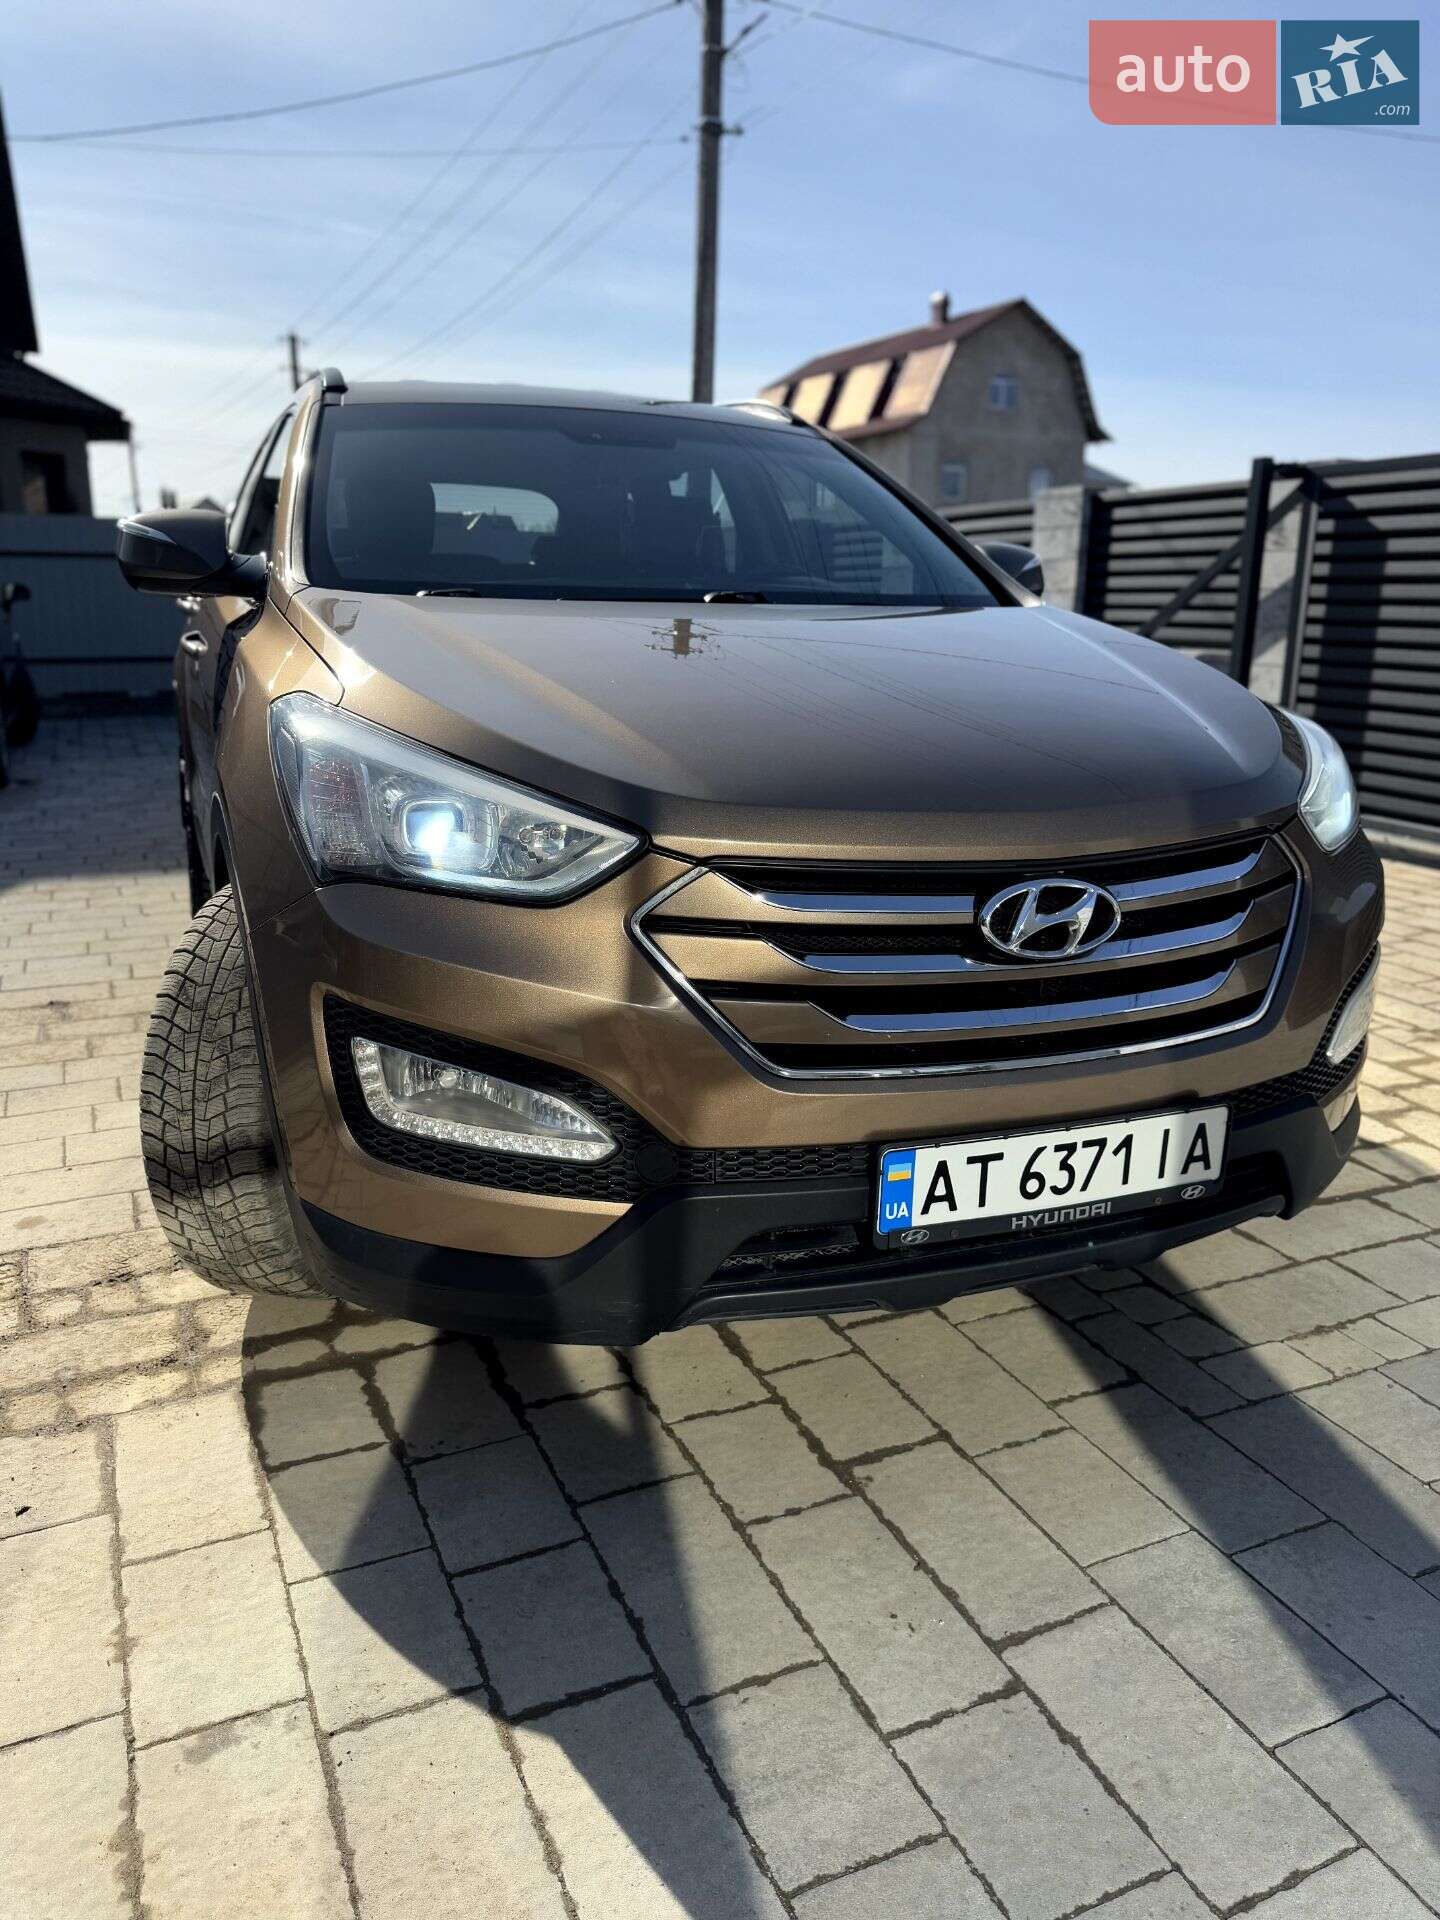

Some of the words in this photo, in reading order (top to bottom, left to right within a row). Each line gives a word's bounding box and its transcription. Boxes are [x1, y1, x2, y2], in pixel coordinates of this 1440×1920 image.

[920, 1152, 1004, 1216] AT
[1018, 1133, 1134, 1200] 6371
[1158, 1123, 1211, 1179] IA
[885, 1202, 909, 1220] UA
[1011, 1201, 1112, 1230] HYUNDAI
